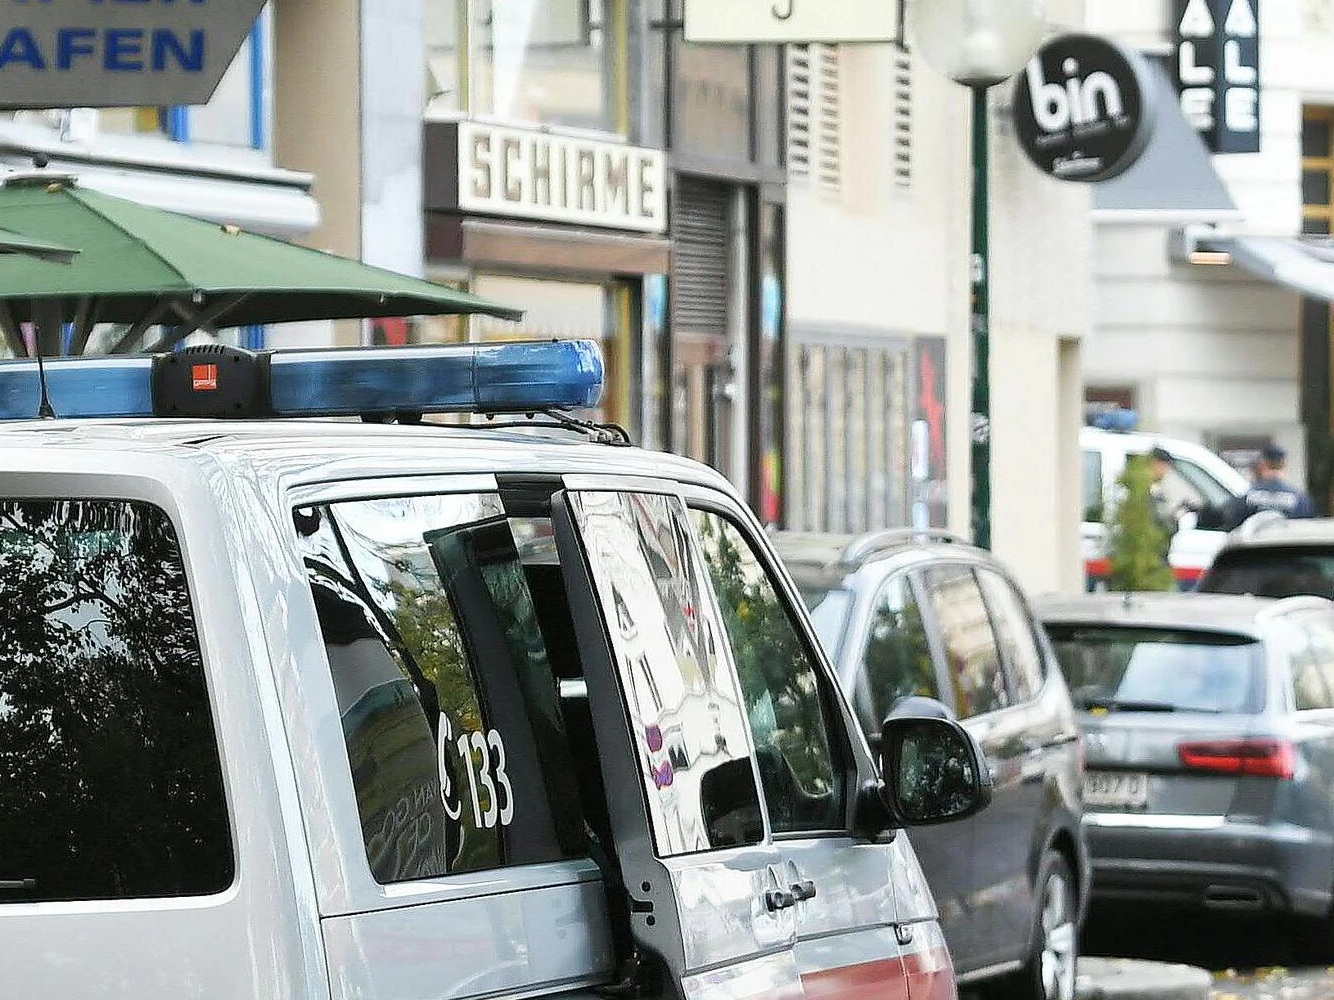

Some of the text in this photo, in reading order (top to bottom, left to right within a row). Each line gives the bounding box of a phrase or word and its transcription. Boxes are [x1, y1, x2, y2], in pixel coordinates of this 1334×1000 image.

[1026, 54, 1124, 133] bin
[470, 132, 655, 219] SCHIRME
[457, 729, 514, 829] 133
